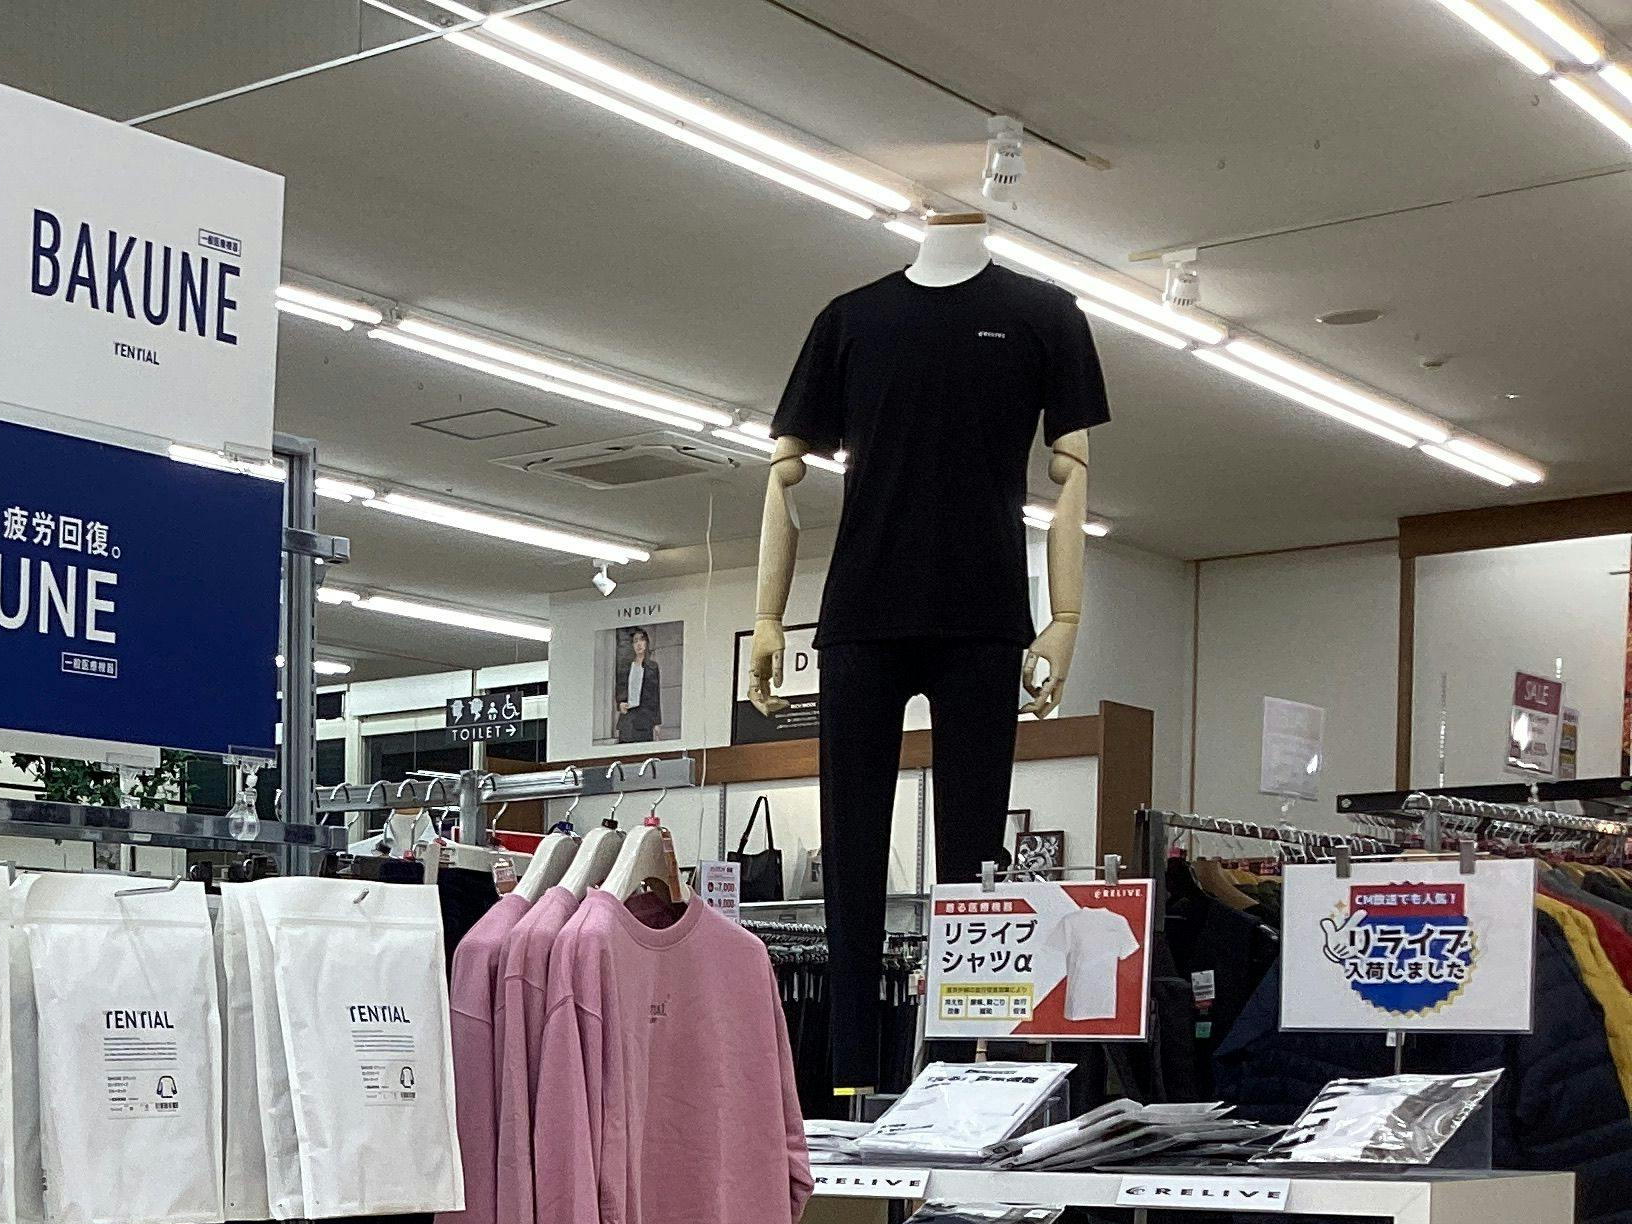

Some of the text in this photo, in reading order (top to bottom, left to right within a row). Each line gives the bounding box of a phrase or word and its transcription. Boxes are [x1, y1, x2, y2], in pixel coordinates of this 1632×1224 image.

[31, 208, 241, 345] BAKUNE
[113, 341, 160, 366] TENTIAL
[617, 603, 661, 618] INDIVI
[452, 726, 501, 741] TOILET
[944, 919, 1038, 945] リライブ
[1349, 928, 1474, 957] リライブ
[942, 951, 1033, 973] シャツα
[1345, 961, 1465, 980] 入荷しました
[104, 1010, 174, 1029] TENTIAL
[348, 1004, 410, 1024] TENTIAL
[815, 1177, 920, 1187] RELIVE
[1155, 1187, 1280, 1199] RELIVE
